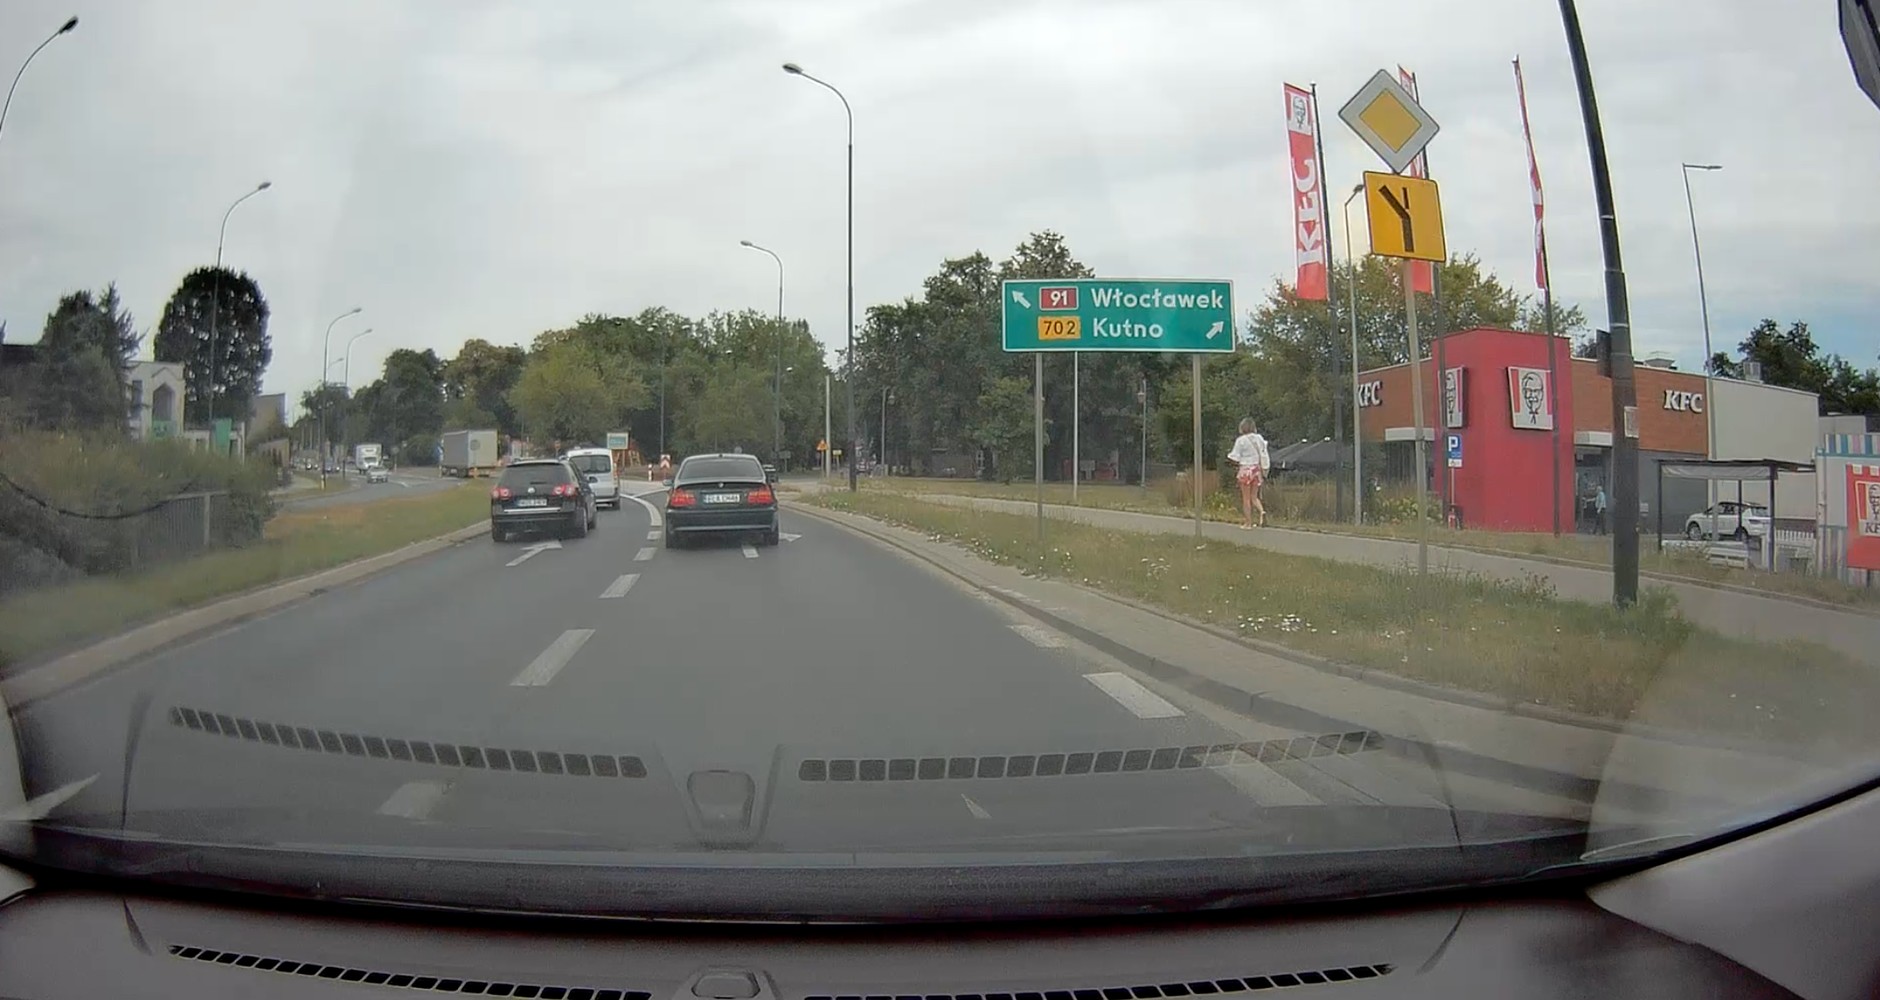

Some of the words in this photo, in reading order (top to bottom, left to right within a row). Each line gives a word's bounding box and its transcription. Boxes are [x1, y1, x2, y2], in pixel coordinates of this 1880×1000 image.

[1293, 158, 1323, 265] KFC
[1050, 291, 1068, 306] 91
[1091, 288, 1223, 309] Włocławek
[1043, 320, 1076, 336] 702
[1093, 318, 1164, 338] Kutno
[1664, 389, 1703, 414] KFC
[1865, 522, 1880, 533] KF
